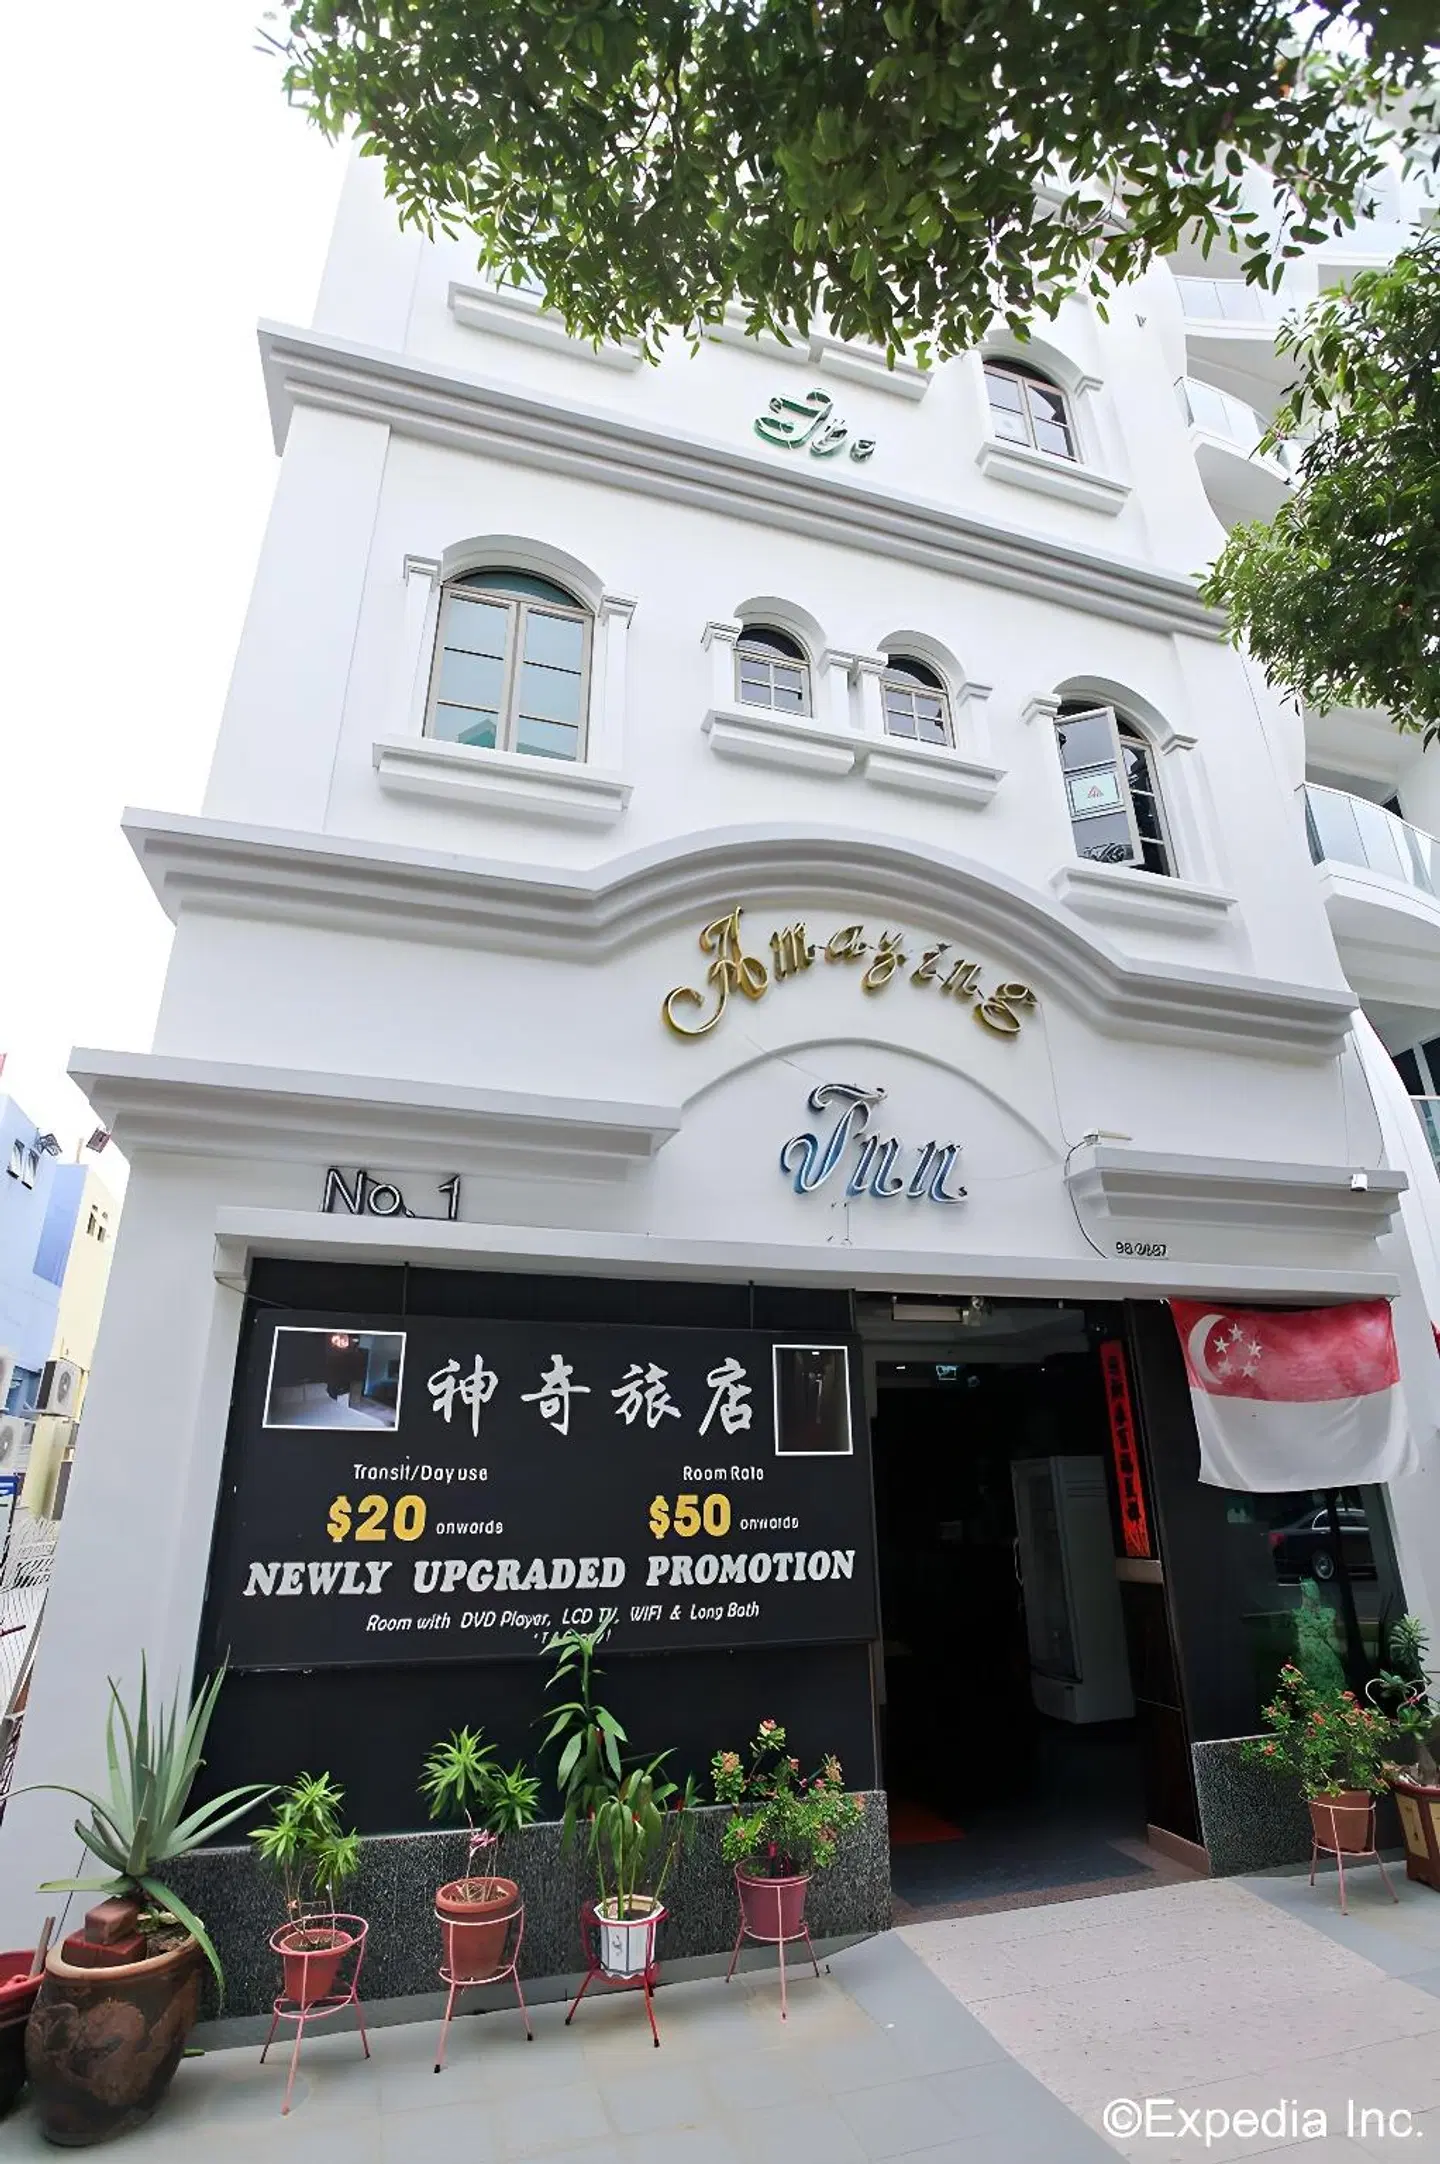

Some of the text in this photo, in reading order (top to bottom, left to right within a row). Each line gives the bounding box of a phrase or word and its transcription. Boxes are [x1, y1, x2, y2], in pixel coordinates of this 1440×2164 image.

[662, 905, 1038, 1036] Amazing
[780, 1083, 969, 1204] Inn
[438, 1173, 461, 1220] 1
[427, 1353, 753, 1437] 神奇旅店
[326, 1494, 504, 1542] $20 onwards
[649, 1493, 731, 1539] $50
[243, 1550, 856, 1595] NEWLY UPGRADED PROMOTION
[366, 1614, 412, 1631] Room
[417, 1612, 451, 1630] with
[460, 1611, 496, 1628] DVD
[500, 1610, 552, 1629] Player,
[562, 1607, 593, 1625] LCD
[669, 1604, 682, 1620] &
[690, 1602, 723, 1621] Long
[727, 1601, 760, 1618] Bath
